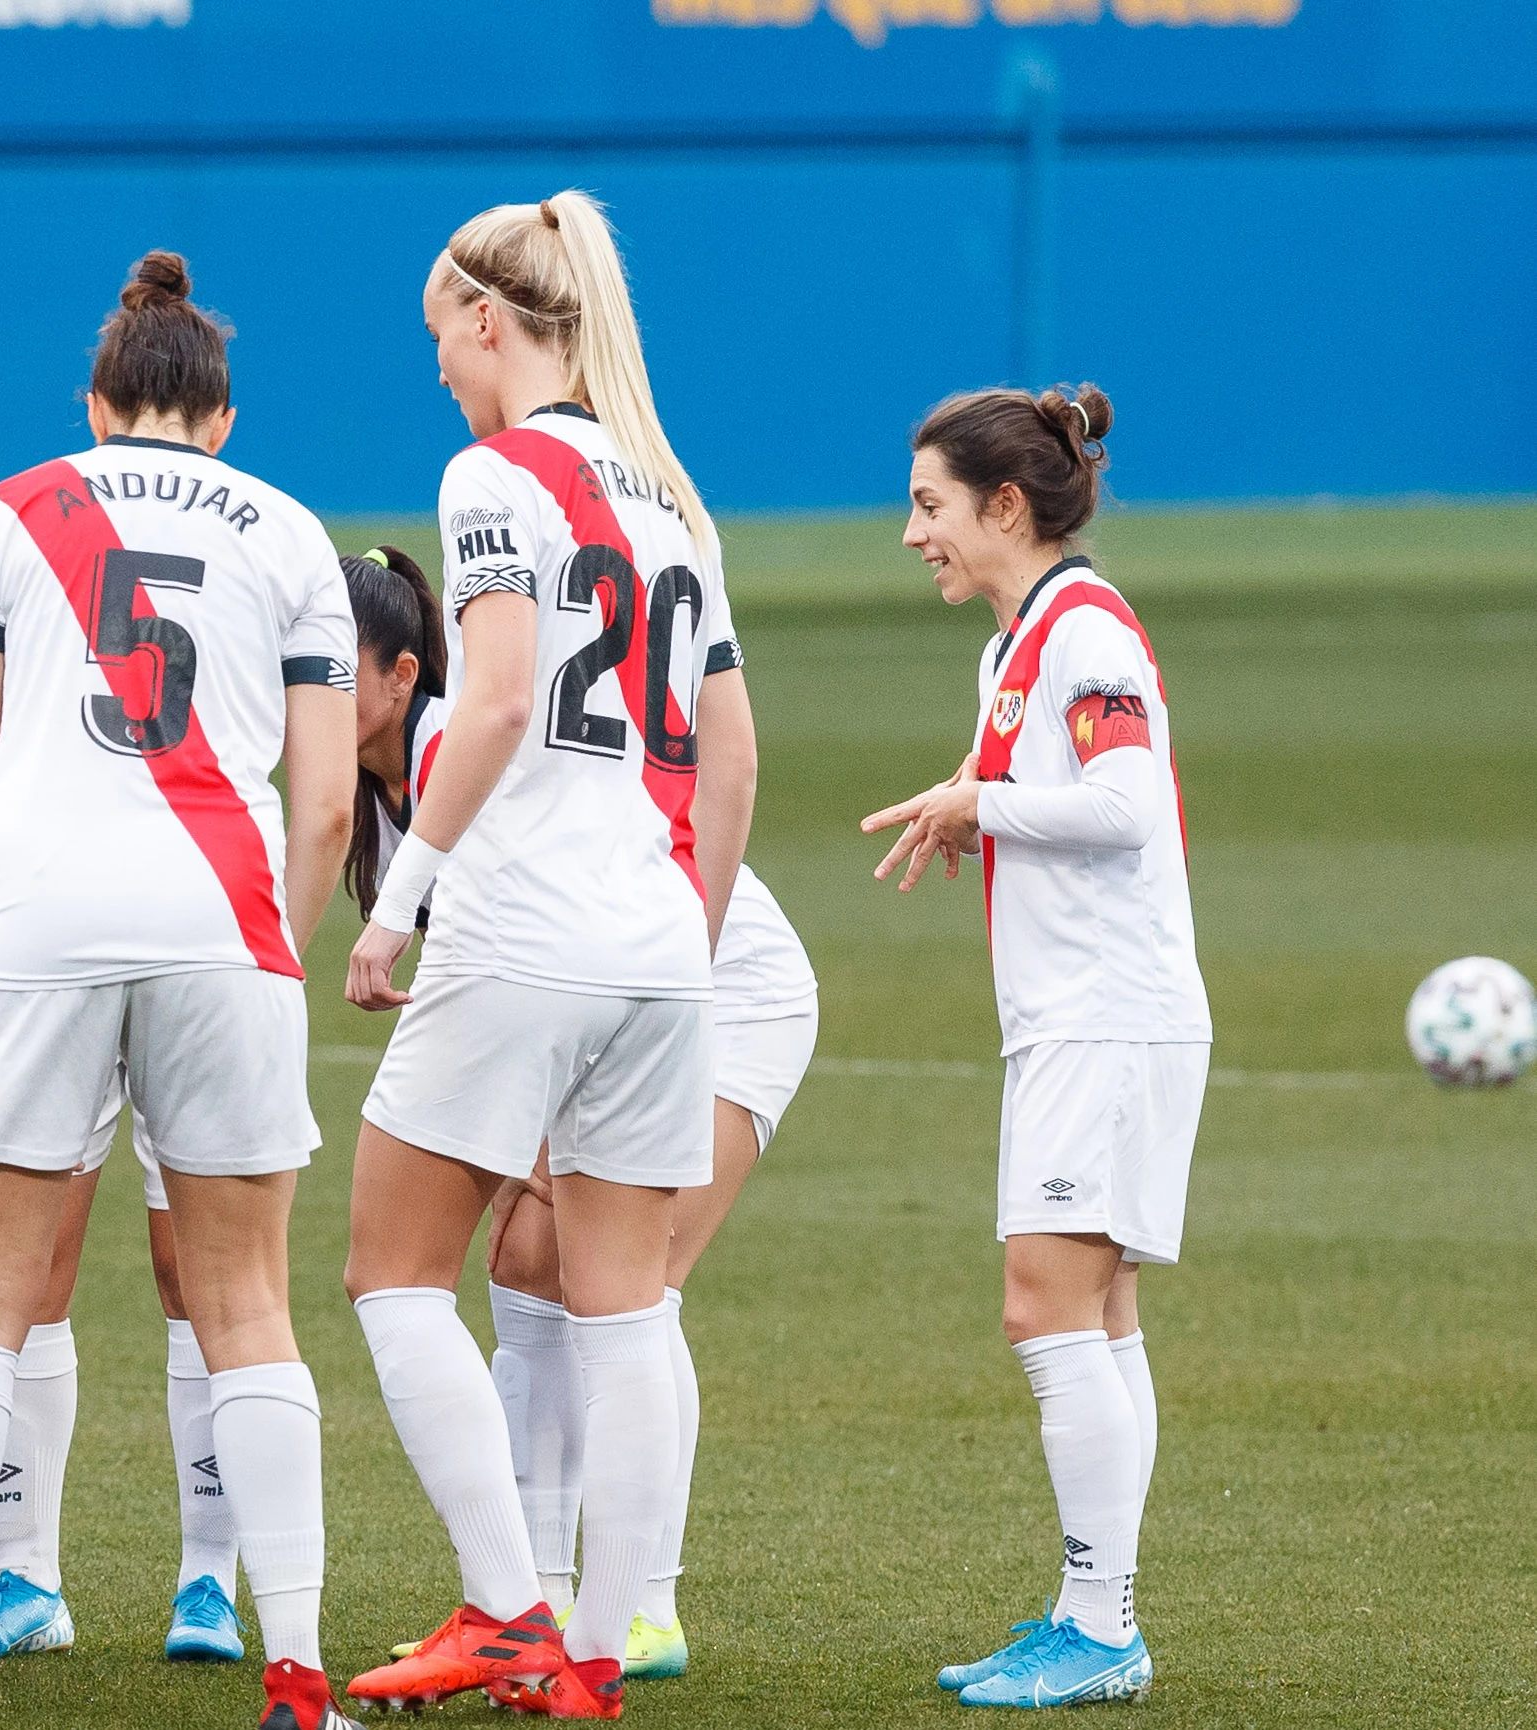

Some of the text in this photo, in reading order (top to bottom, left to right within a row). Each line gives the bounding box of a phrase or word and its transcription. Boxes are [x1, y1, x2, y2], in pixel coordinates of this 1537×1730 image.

[55, 469, 260, 536] ANDÚJAR
[450, 506, 514, 536] William
[577, 459, 692, 534] STRUC
[457, 528, 519, 565] HILL
[81, 548, 206, 758] 5
[545, 543, 703, 774] 20
[1044, 1194, 1073, 1202] umbro
